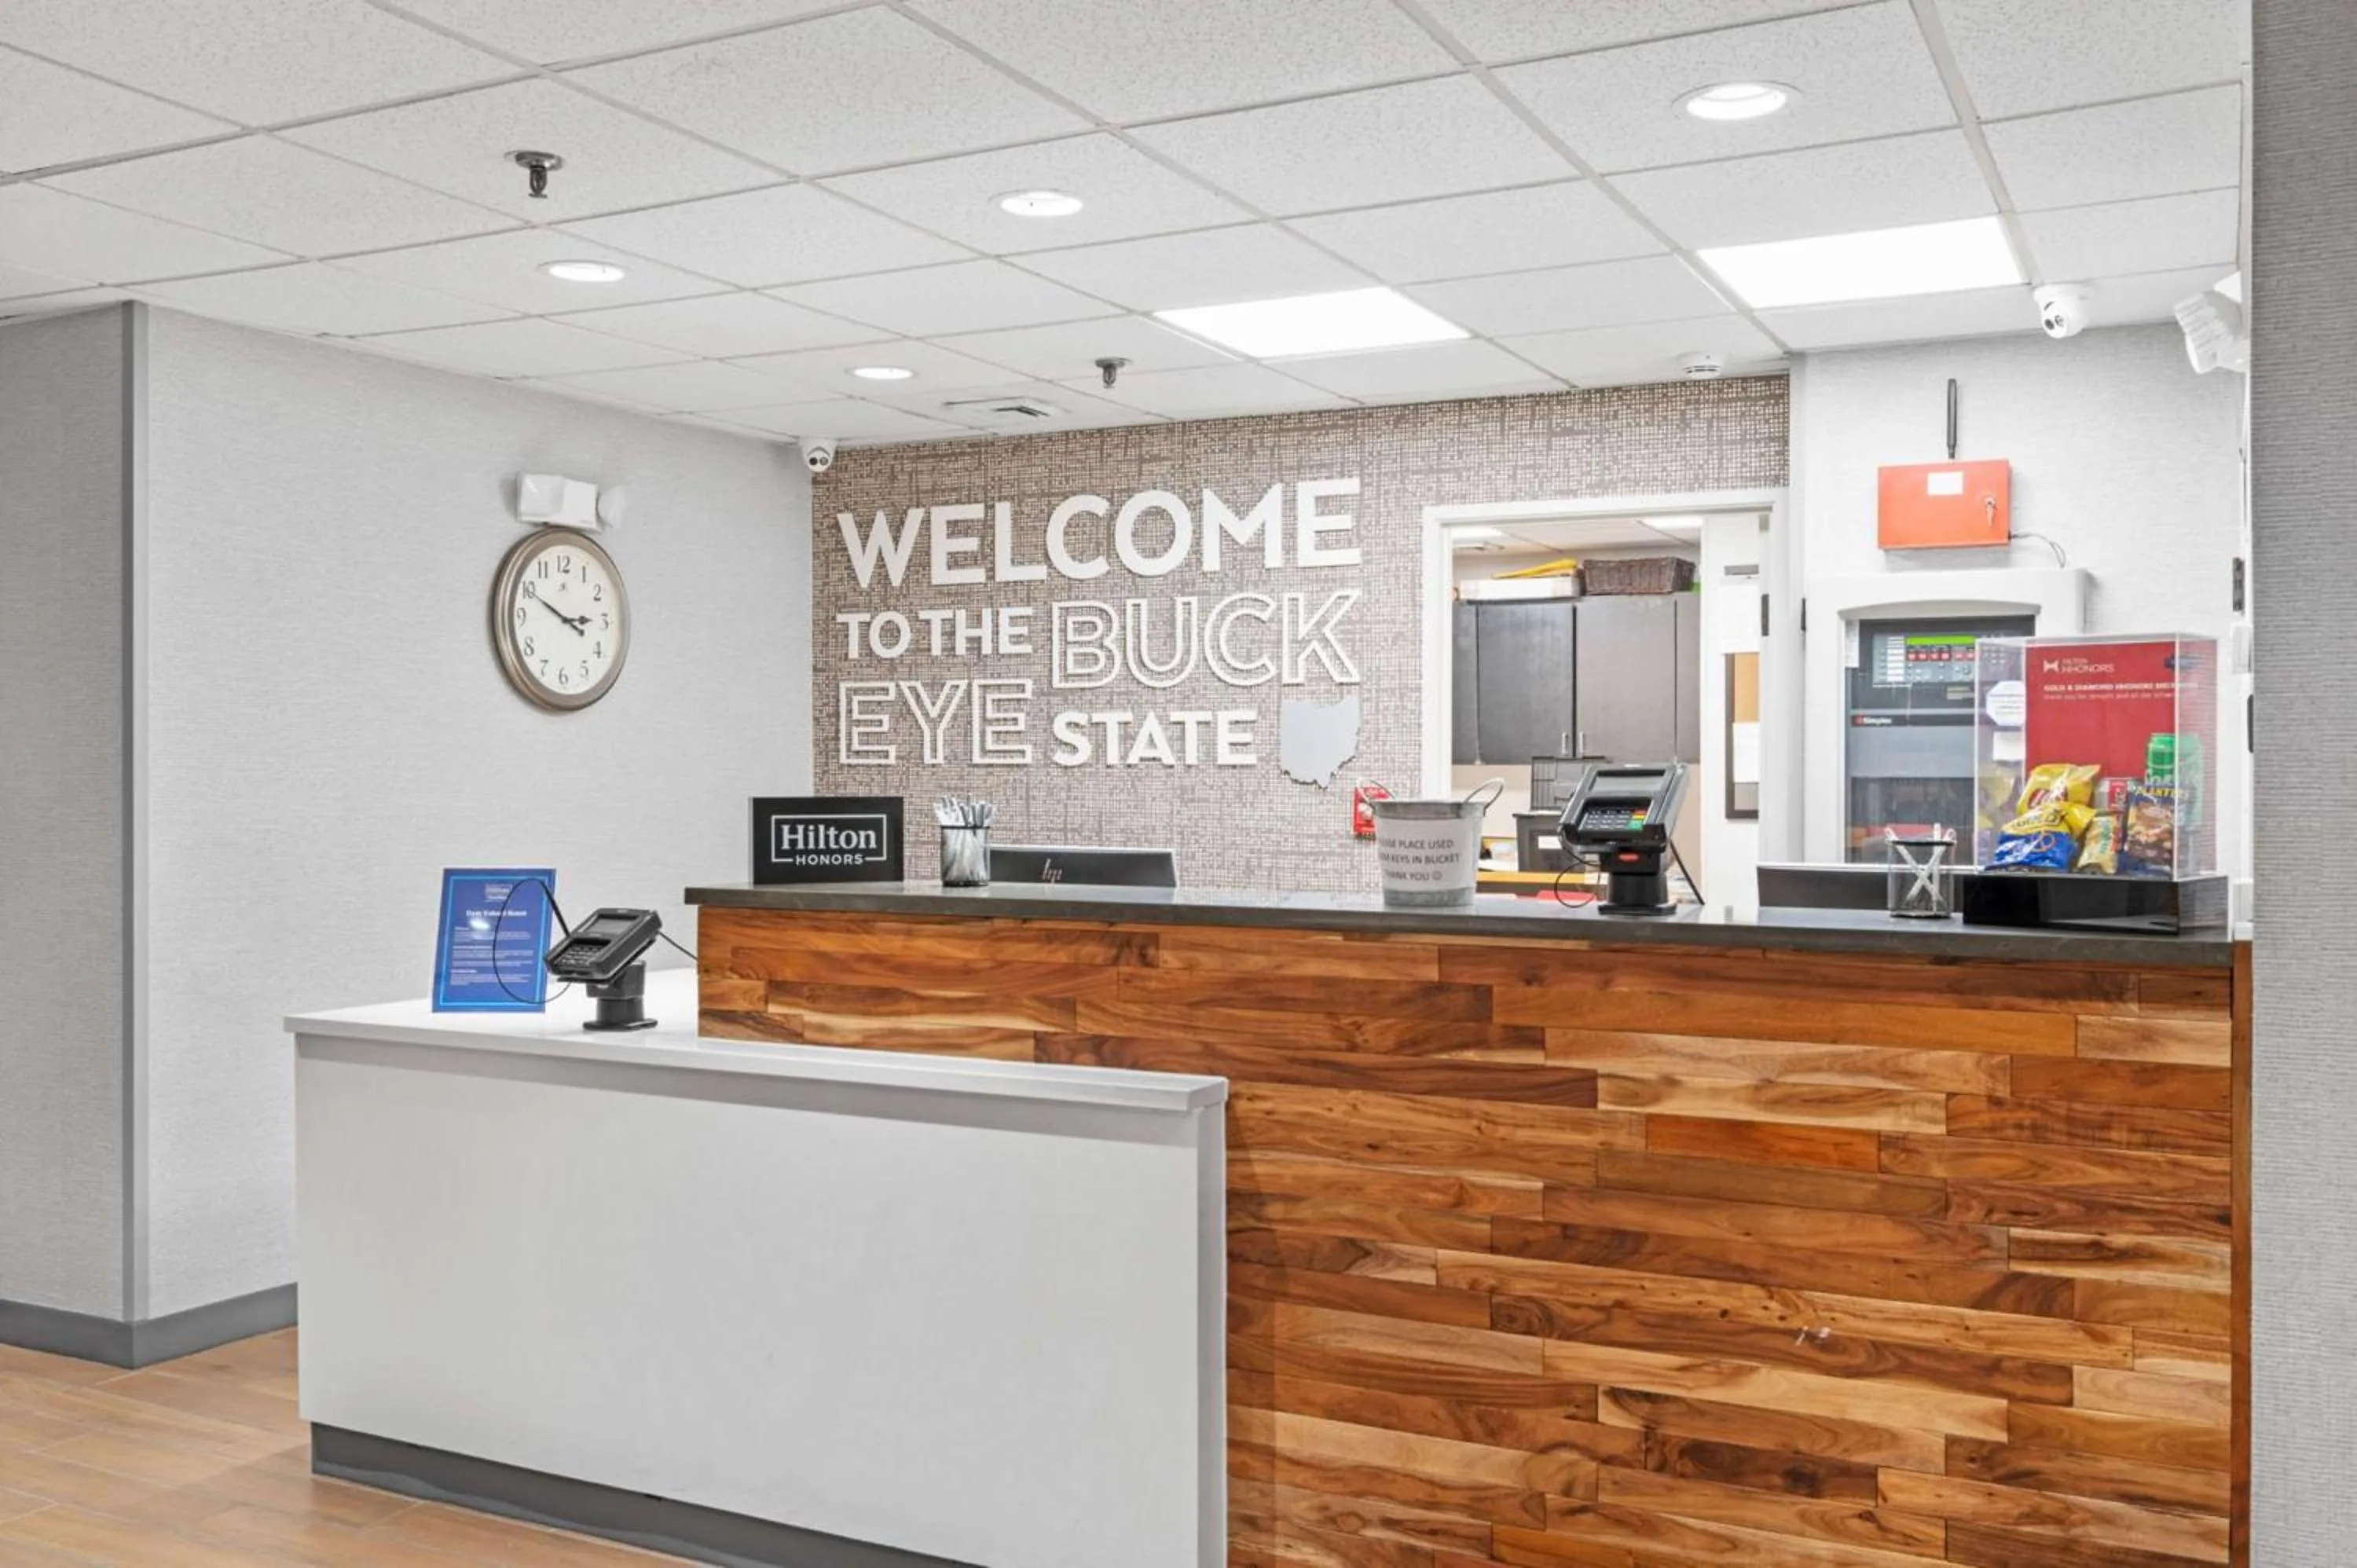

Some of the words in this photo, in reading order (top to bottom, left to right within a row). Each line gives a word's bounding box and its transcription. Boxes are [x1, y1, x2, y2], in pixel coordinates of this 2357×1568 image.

[838, 477, 1361, 588] WELCOME
[537, 560, 548, 579] 11
[556, 555, 571, 573] 12
[581, 565, 587, 584] 1
[522, 581, 536, 599] 10
[593, 584, 601, 602] 2
[516, 607, 526, 627] 9
[599, 613, 610, 631] 3
[523, 636, 535, 657] 8
[838, 611, 911, 660] TO
[918, 606, 1033, 657] THE
[1051, 589, 1361, 690] BUCK
[593, 640, 602, 659] 4
[540, 659, 549, 677] 7
[559, 666, 569, 686] 6
[580, 660, 589, 679] 5
[838, 679, 1033, 766] EYE
[1051, 709, 1258, 768] STATE
[781, 824, 877, 850] Hilton
[1398, 839, 1425, 849] PLACE
[1428, 839, 1454, 849] USED
[795, 854, 863, 866] HONORS
[1412, 855, 1422, 864] IN
[1424, 853, 1460, 865] BUCKET
[1409, 870, 1429, 881] YOU
